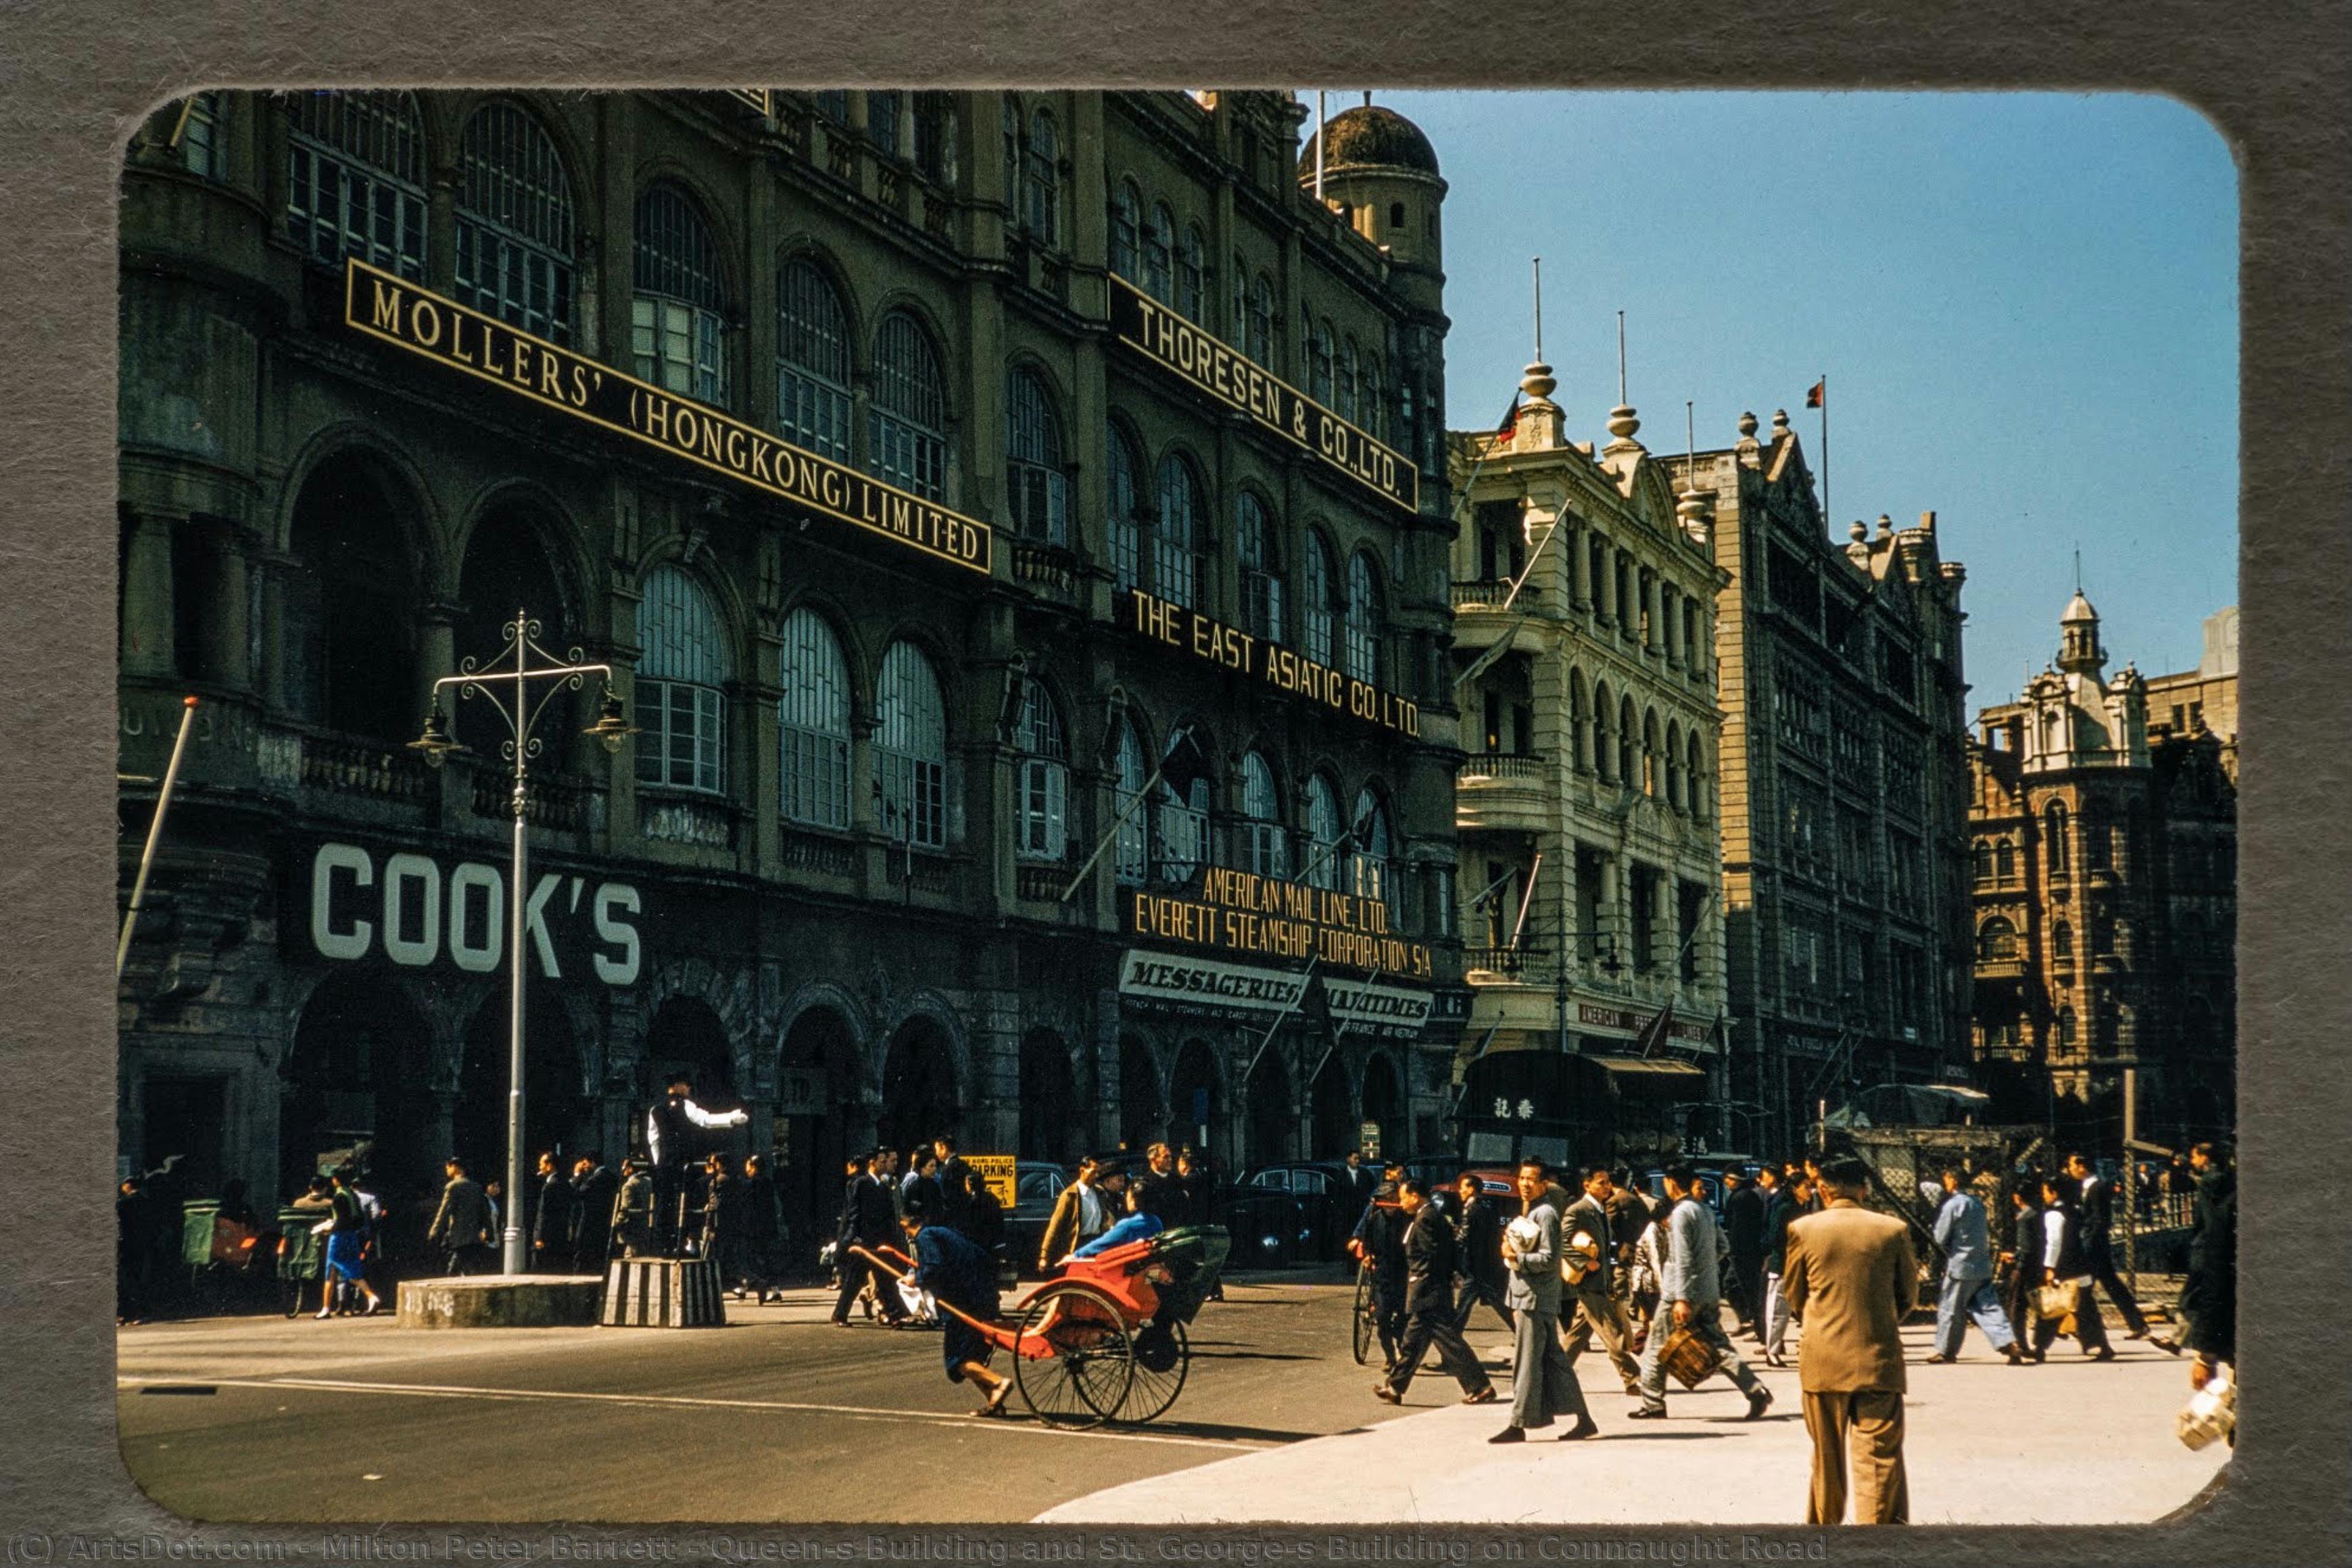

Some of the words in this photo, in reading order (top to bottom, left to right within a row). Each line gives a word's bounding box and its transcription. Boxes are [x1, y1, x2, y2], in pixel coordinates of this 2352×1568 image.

[373, 280, 601, 406] MOLLERS'
[631, 388, 850, 512] (HONGKONG)
[863, 483, 978, 560] LIMITED
[1138, 299, 1281, 425] THORESEN
[1293, 399, 1307, 441] &
[1132, 589, 1181, 646] THE
[1193, 614, 1253, 673] EAST
[1266, 645, 1342, 707] ASIATIC
[1351, 680, 1379, 722] CO.
[312, 842, 642, 985] COOK'S
[1135, 893, 1218, 944] EVERETT
[1225, 911, 1313, 958] STEAMSHIP
[1318, 927, 1408, 972] CORPORATION
[1203, 867, 1280, 914] AMERICAN
[1285, 881, 1317, 922] MAIL
[1321, 888, 1355, 933] LINE,
[1359, 898, 1388, 935] LTD.
[1129, 960, 1303, 1005] MESSAGERIES
